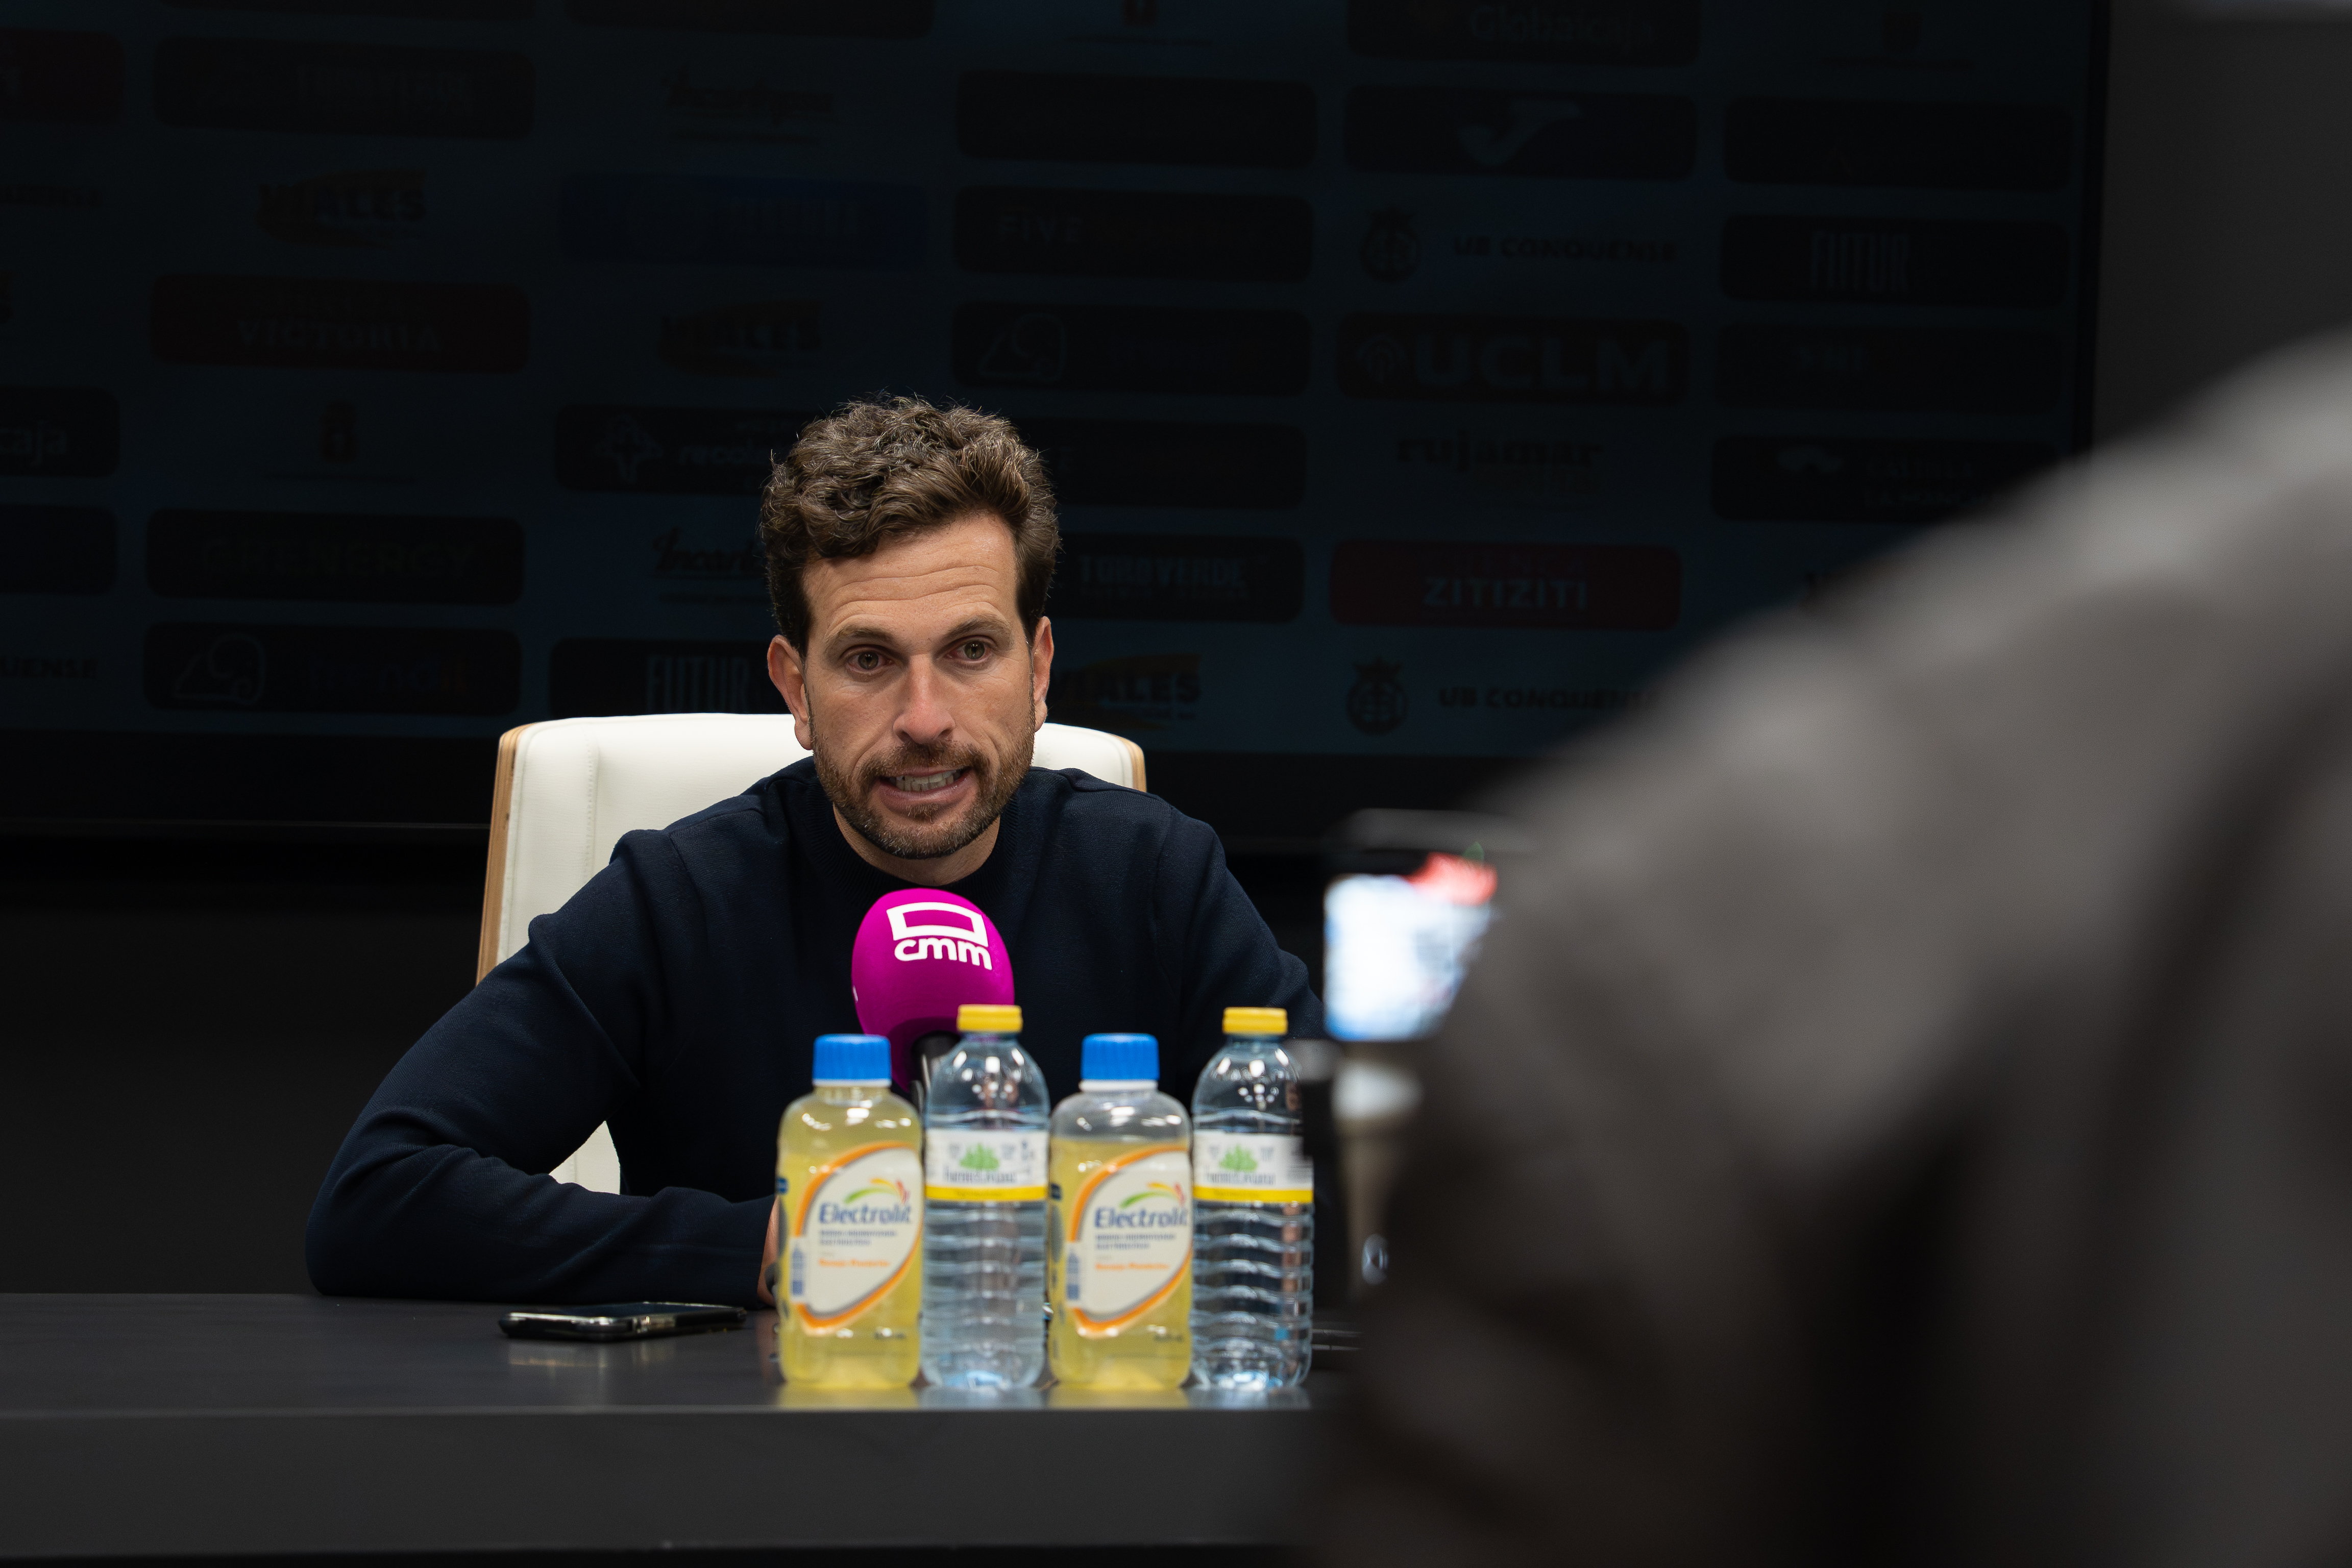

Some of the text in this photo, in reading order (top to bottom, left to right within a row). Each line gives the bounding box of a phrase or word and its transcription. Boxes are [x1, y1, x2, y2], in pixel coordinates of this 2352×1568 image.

[1468, 4, 1655, 57] Globalcaja
[257, 183, 427, 223] VIALES
[997, 214, 1084, 249] FIVE
[1453, 236, 1676, 262] UB CONQUENSE
[237, 318, 442, 352] VICTORIA
[662, 315, 821, 350] VIALES
[1414, 332, 1670, 393] UCLM
[1398, 429, 1604, 473] rujamar
[202, 536, 477, 578] GRENERGY
[1079, 554, 1248, 587] TOROVERDE
[1422, 576, 1587, 610] ZITIZITI
[645, 654, 750, 711] FUTUR
[1439, 687, 1477, 707] UB
[894, 938, 992, 970] cmm
[819, 1202, 911, 1226] Electrolit
